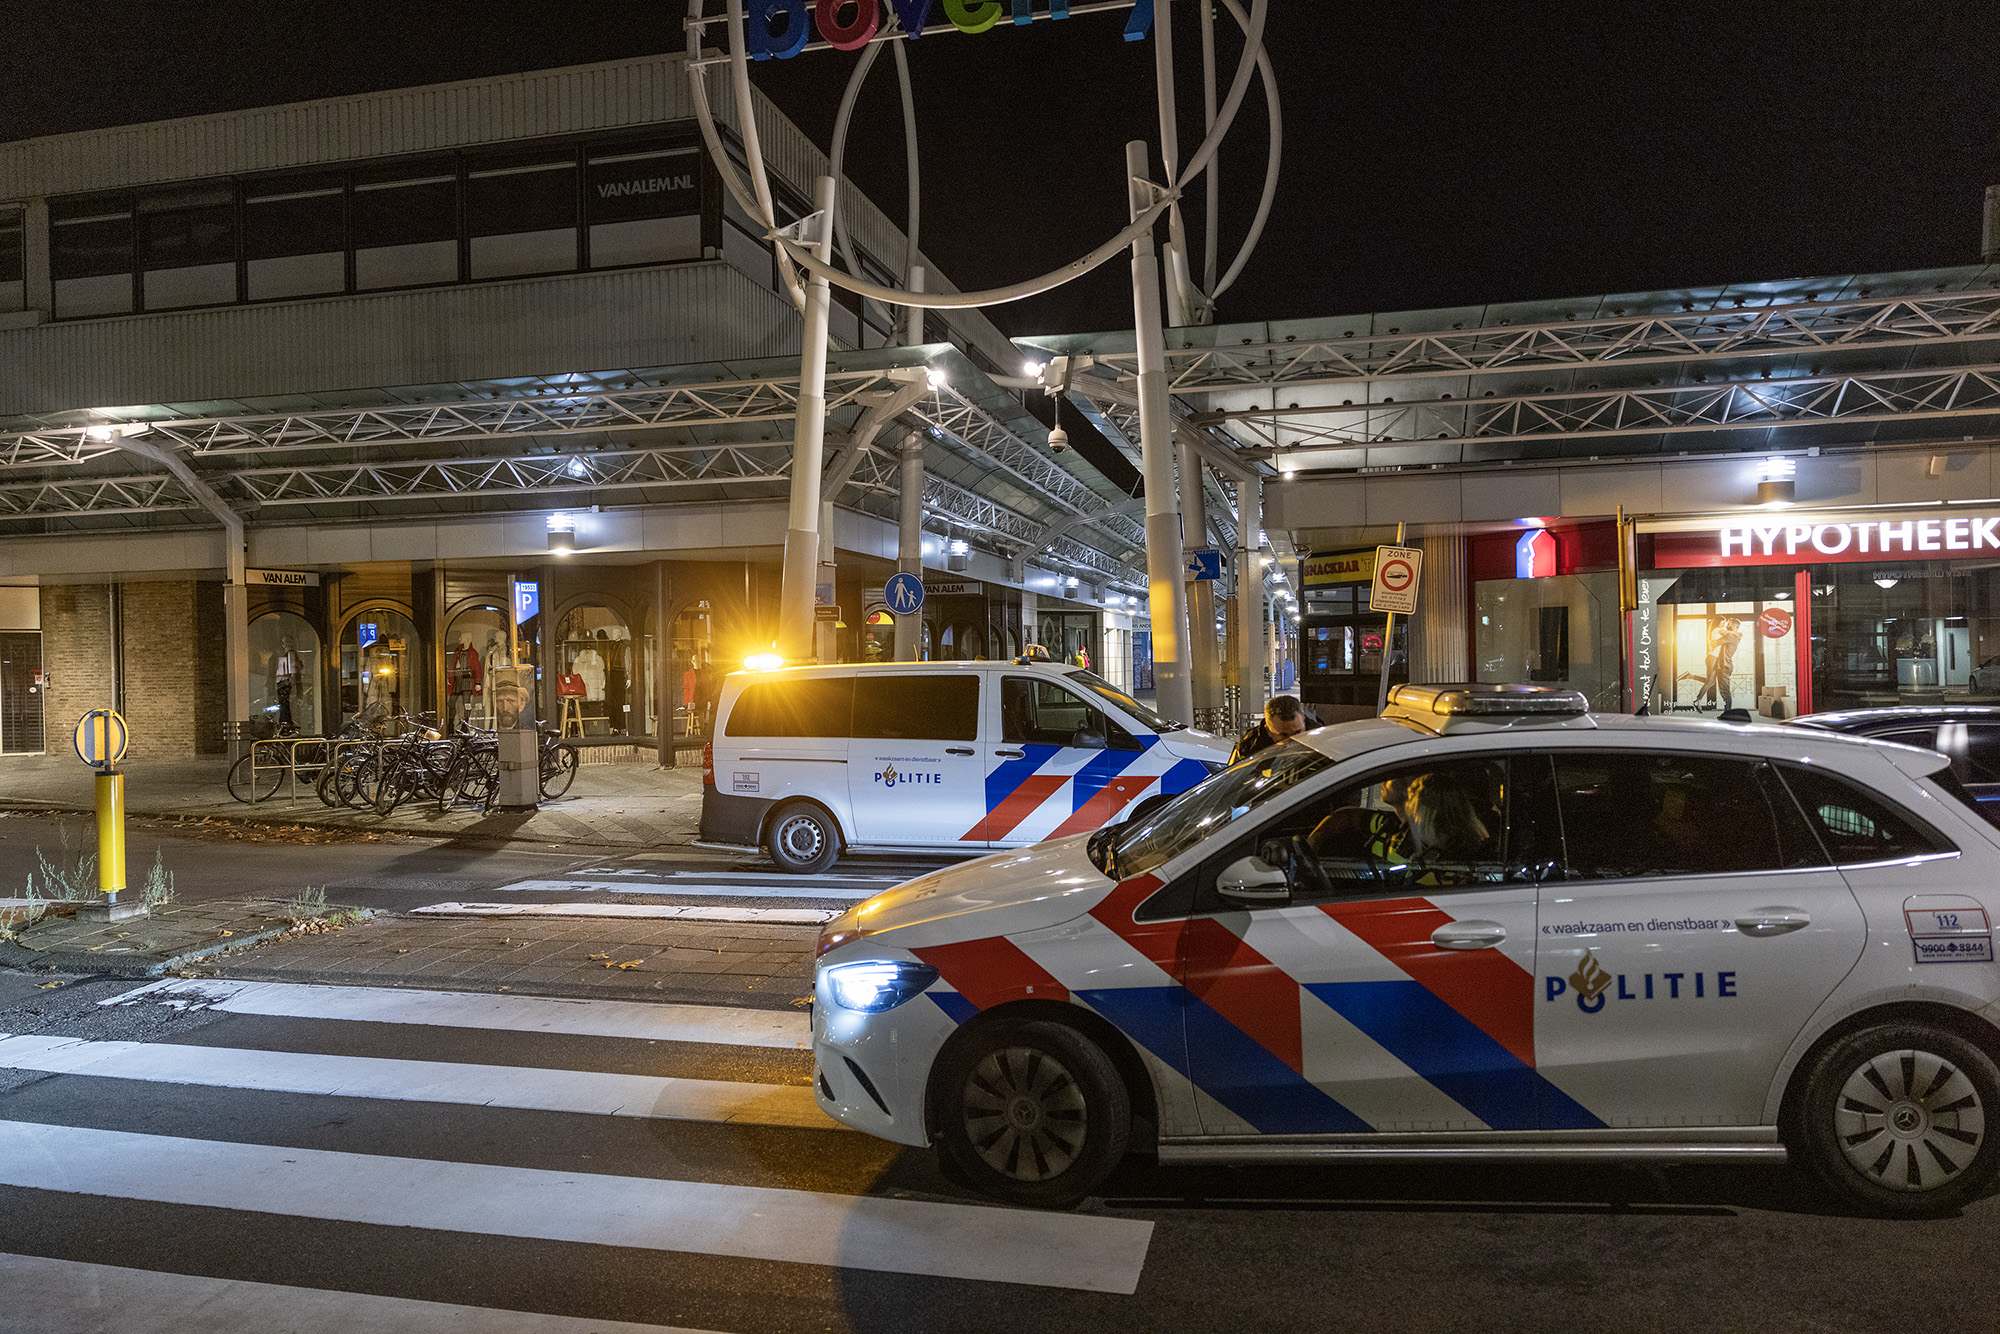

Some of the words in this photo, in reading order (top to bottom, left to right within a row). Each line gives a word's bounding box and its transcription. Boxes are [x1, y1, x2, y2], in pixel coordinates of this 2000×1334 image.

[1720, 516, 2000, 557] HYPOTHEEK
[1387, 550, 1412, 559] ZONE
[1304, 560, 1360, 577] SNACKBAR
[262, 572, 282, 584] VAN
[283, 574, 307, 585] ALEM
[941, 584, 965, 593] ALEM
[522, 593, 533, 611] P
[874, 772, 942, 788] POLITIE
[1552, 921, 1625, 934] waakzaam
[1627, 923, 1645, 932] en
[1647, 917, 1719, 931] dienstbaar
[1936, 914, 1958, 926] 112
[1545, 971, 1738, 1014] POLITIE
